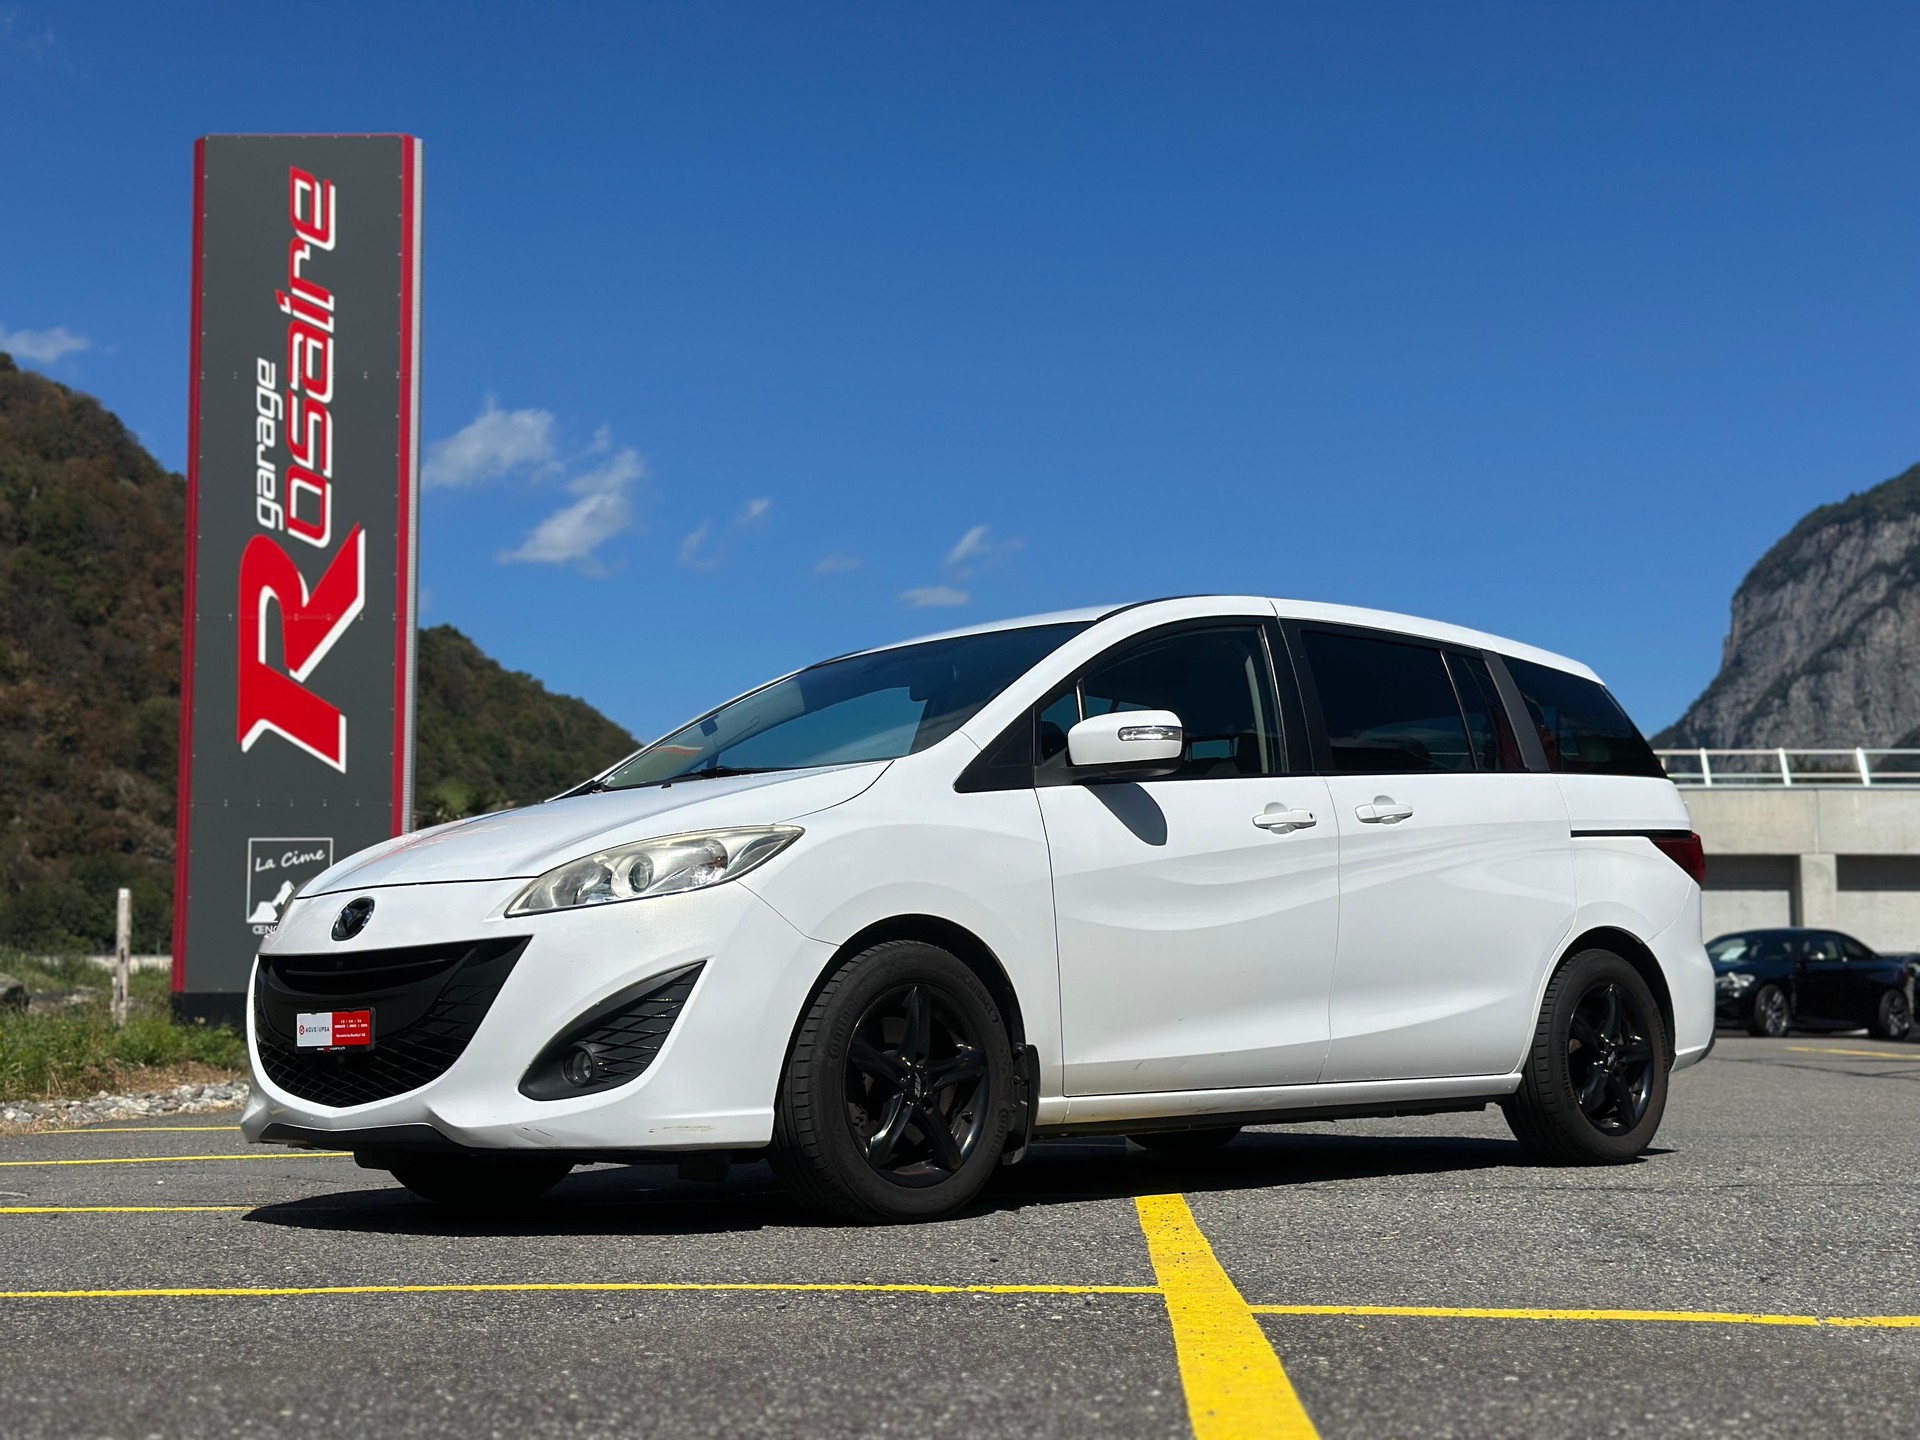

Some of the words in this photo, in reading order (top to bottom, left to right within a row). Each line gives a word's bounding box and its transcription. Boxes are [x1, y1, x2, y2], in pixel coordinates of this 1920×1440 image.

[237, 165, 366, 774] Rosaire
[256, 358, 283, 530] garage
[255, 857, 276, 872] La
[281, 849, 326, 868] Cime
